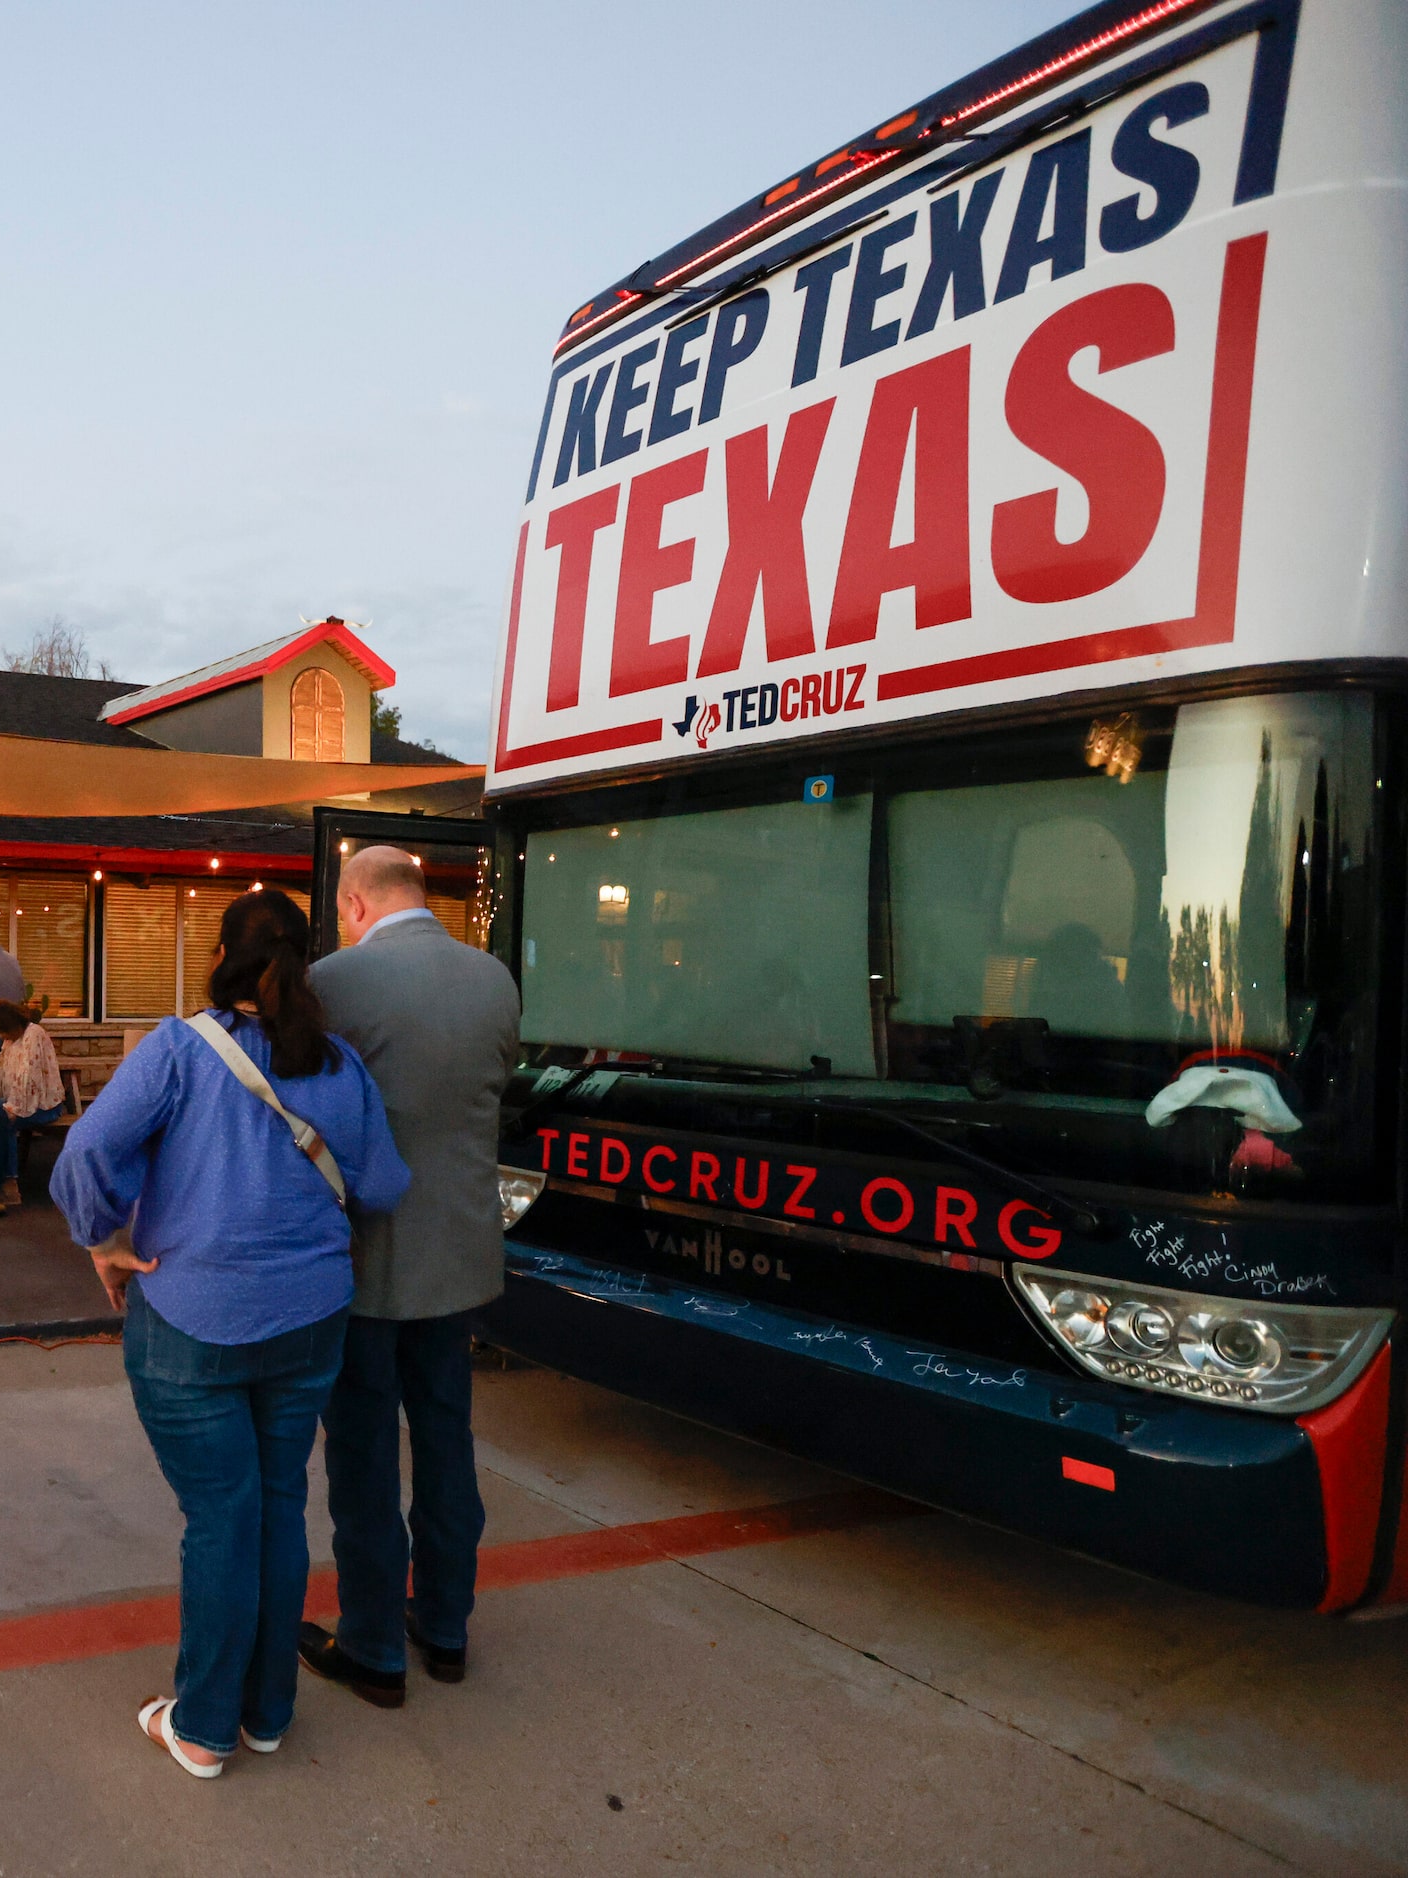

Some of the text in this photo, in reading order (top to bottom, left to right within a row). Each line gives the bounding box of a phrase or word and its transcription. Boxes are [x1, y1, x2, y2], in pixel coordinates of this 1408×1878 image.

[553, 81, 1210, 488] KEEP TEXAS
[545, 282, 1176, 714] TEXAS
[537, 1128, 1062, 1259] TEDCRUZ.ORG
[1129, 1221, 1165, 1248] Fight
[1146, 1236, 1184, 1266] Fight
